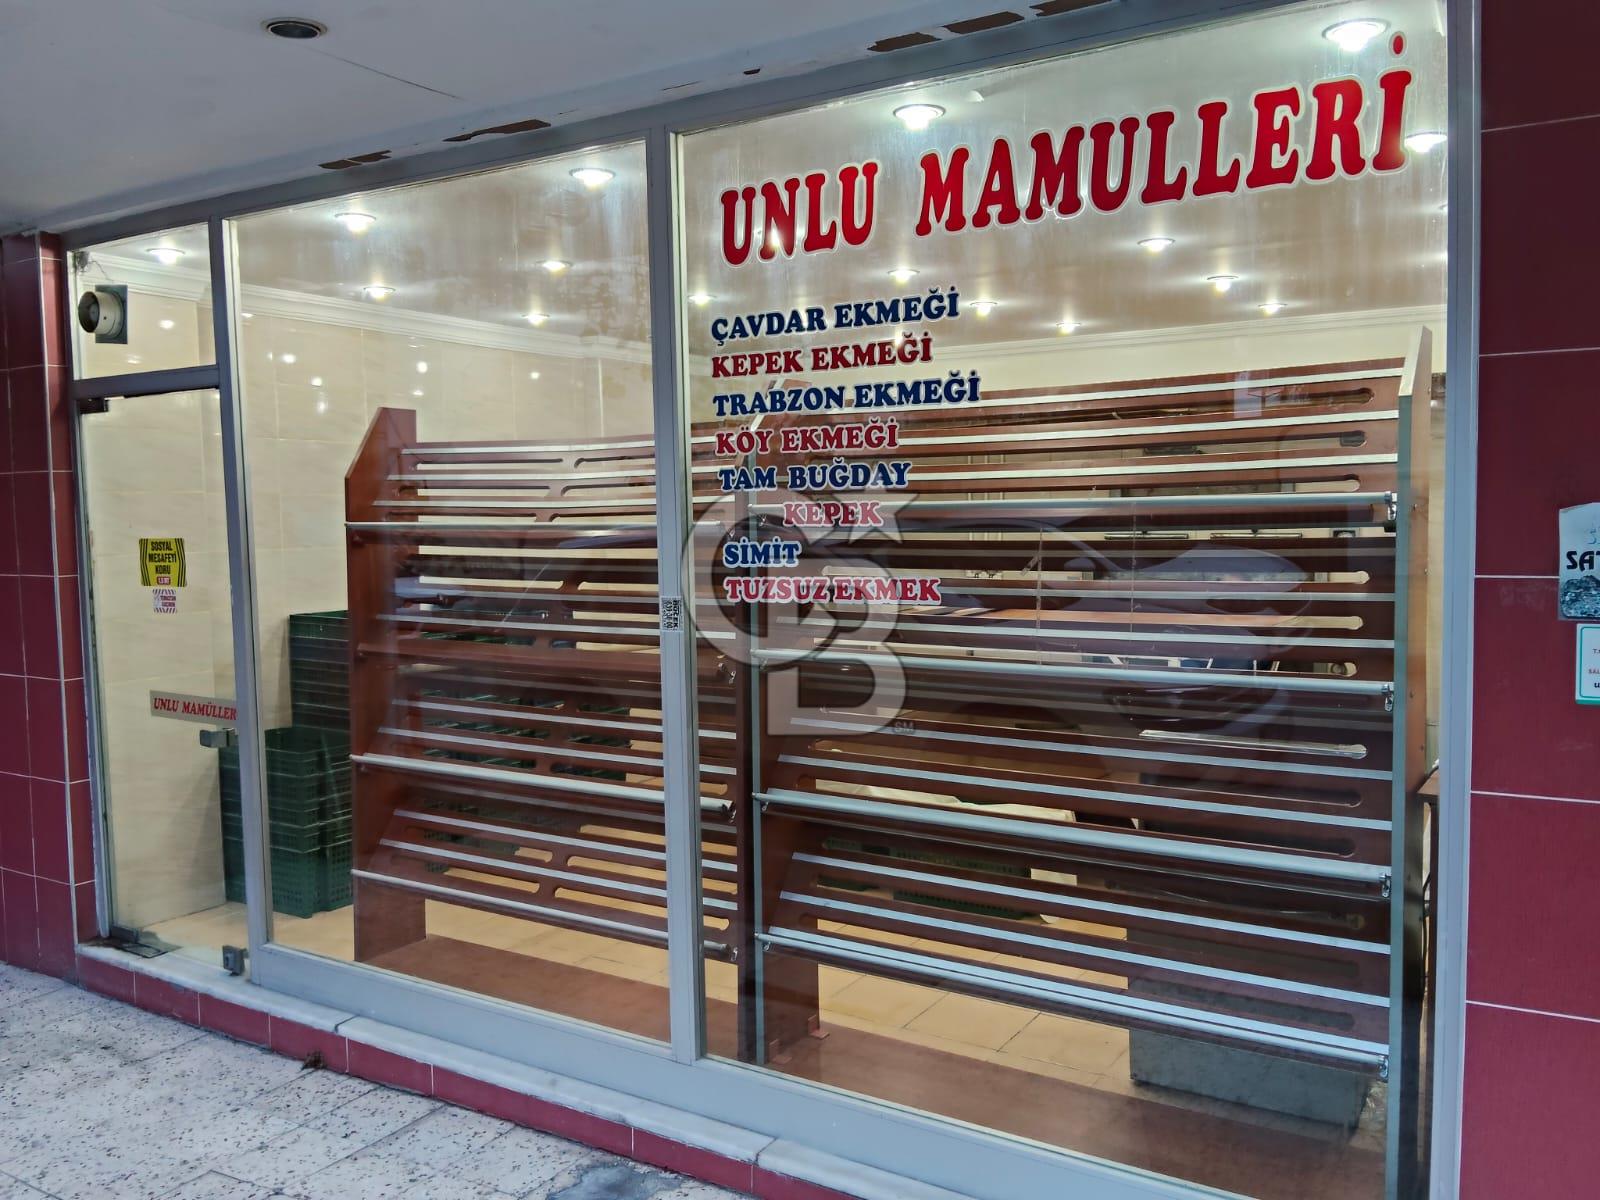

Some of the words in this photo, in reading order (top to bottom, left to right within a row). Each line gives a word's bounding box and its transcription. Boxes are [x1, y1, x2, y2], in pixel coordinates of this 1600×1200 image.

[720, 161, 878, 265] UNLU
[915, 35, 1412, 236] MAMULLERİ
[711, 307, 826, 345] ÇAVDAR
[834, 286, 959, 328] EKMEĞİ
[711, 349, 803, 378] KEPEK
[811, 332, 932, 371] EKMEĞİ
[713, 386, 844, 416] TRABZON
[854, 370, 980, 408] EKMEĞİ
[715, 427, 773, 454] KÖY
[782, 418, 898, 451] EKMEĞİ
[719, 467, 776, 490] TAM
[788, 458, 911, 489] BUĞDAY
[783, 502, 882, 525] KEPEK
[724, 537, 800, 566] SİMİT
[725, 578, 830, 601] TUZSUZ
[833, 578, 941, 602] EKMEK
[154, 698, 179, 712] UNLU
